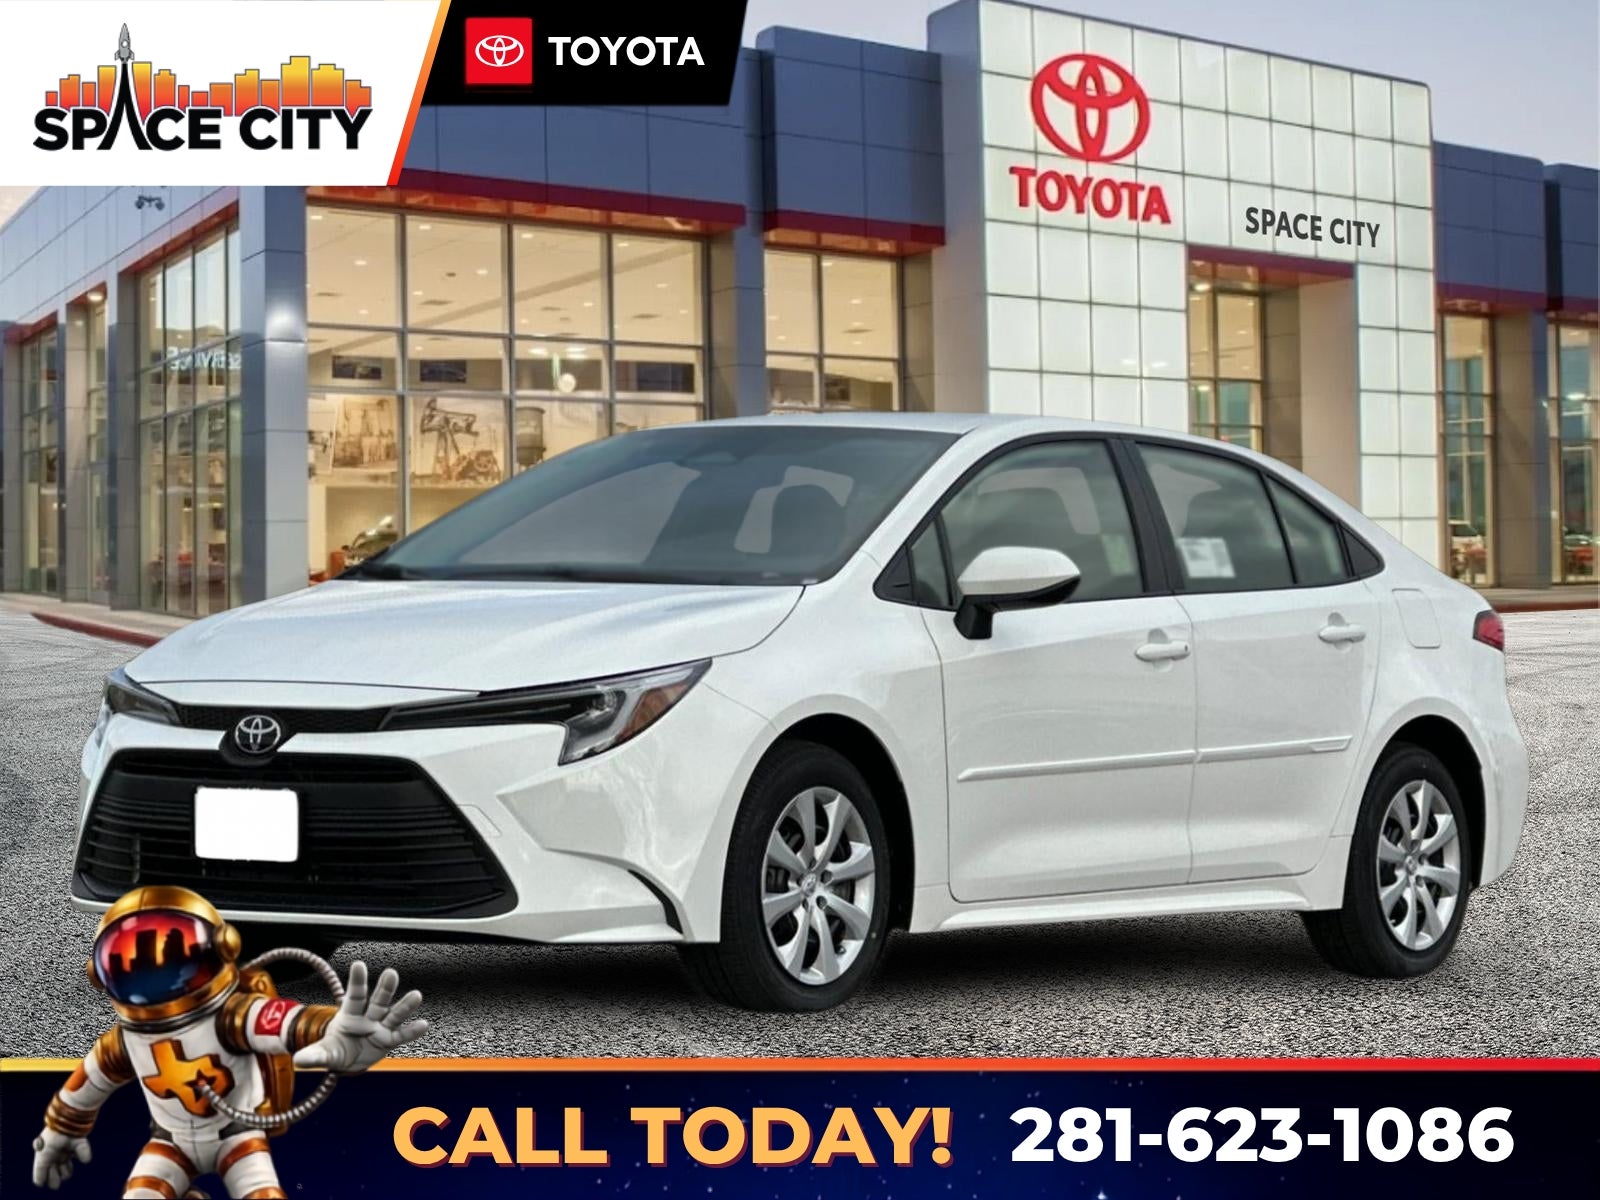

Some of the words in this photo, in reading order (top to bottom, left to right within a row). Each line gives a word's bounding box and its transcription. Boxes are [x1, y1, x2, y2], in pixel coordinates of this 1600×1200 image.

[1009, 165, 1171, 225] TOYOTA
[1245, 206, 1323, 242] SPACE
[1329, 218, 1381, 248] CITY
